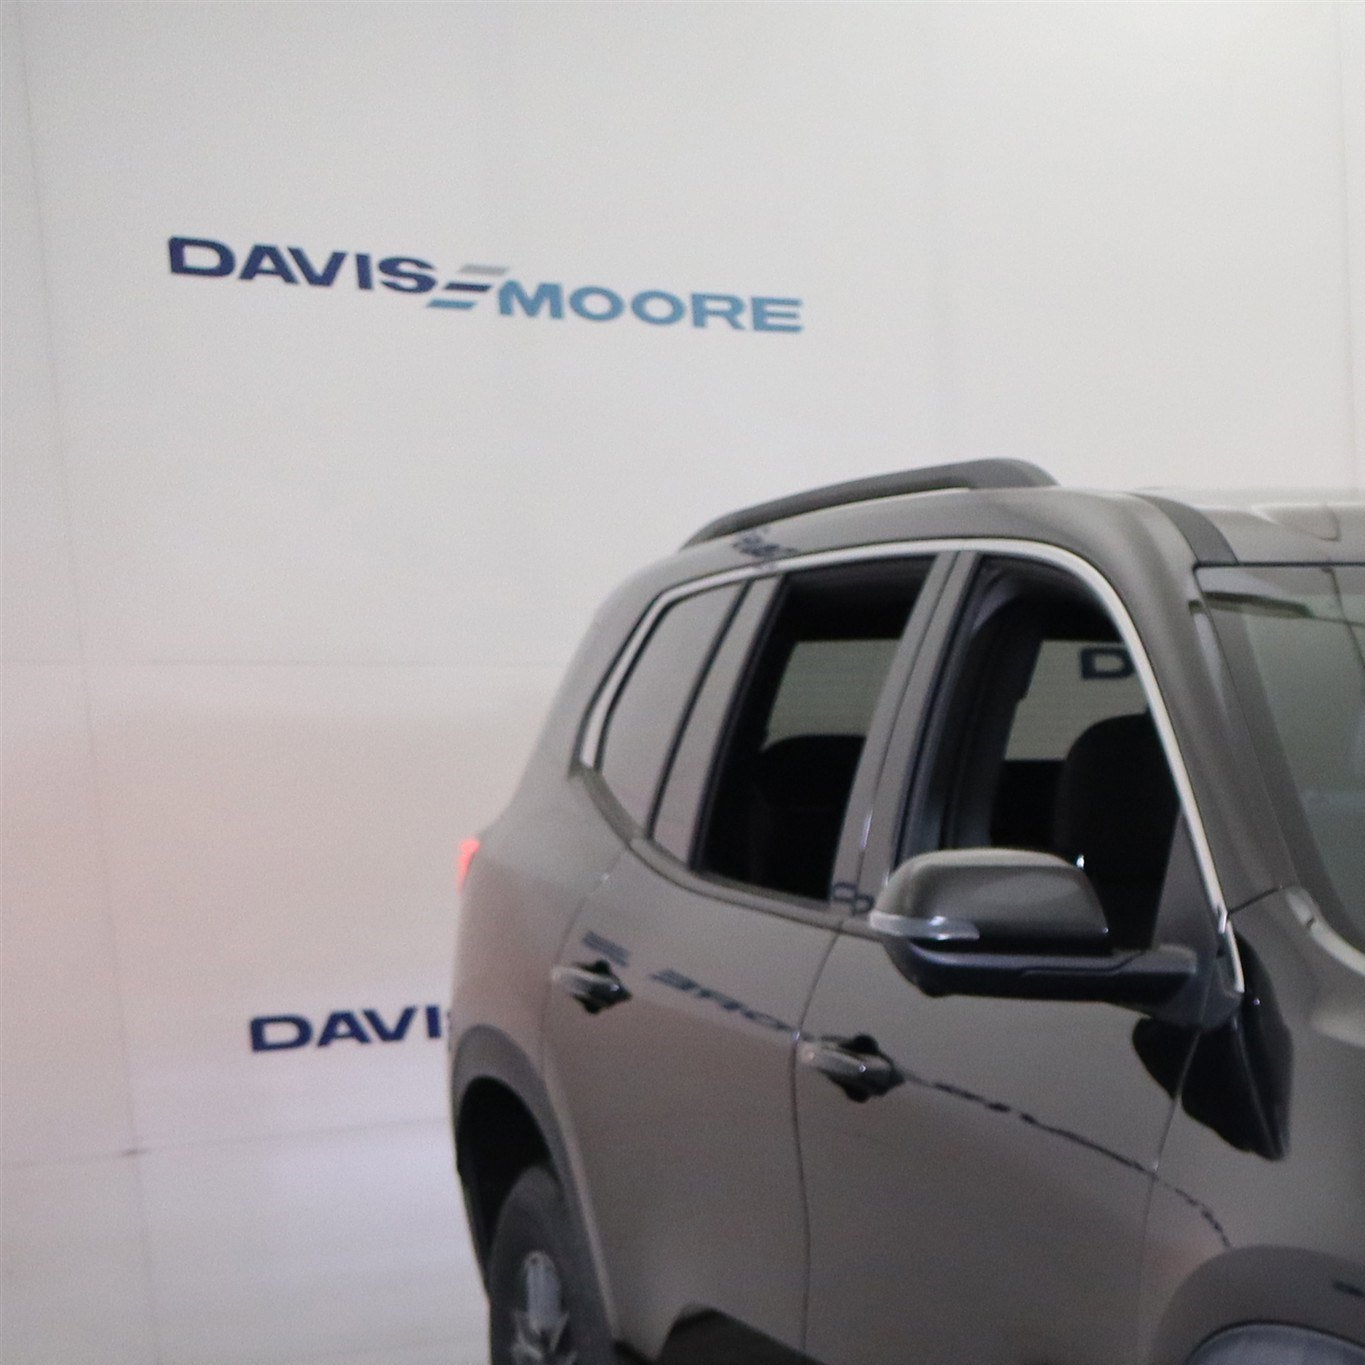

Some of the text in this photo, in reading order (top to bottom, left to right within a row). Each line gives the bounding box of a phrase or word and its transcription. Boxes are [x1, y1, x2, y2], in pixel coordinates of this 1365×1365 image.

[167, 235, 805, 333] DAVIS MOORE
[249, 1003, 450, 1053] DAVI
